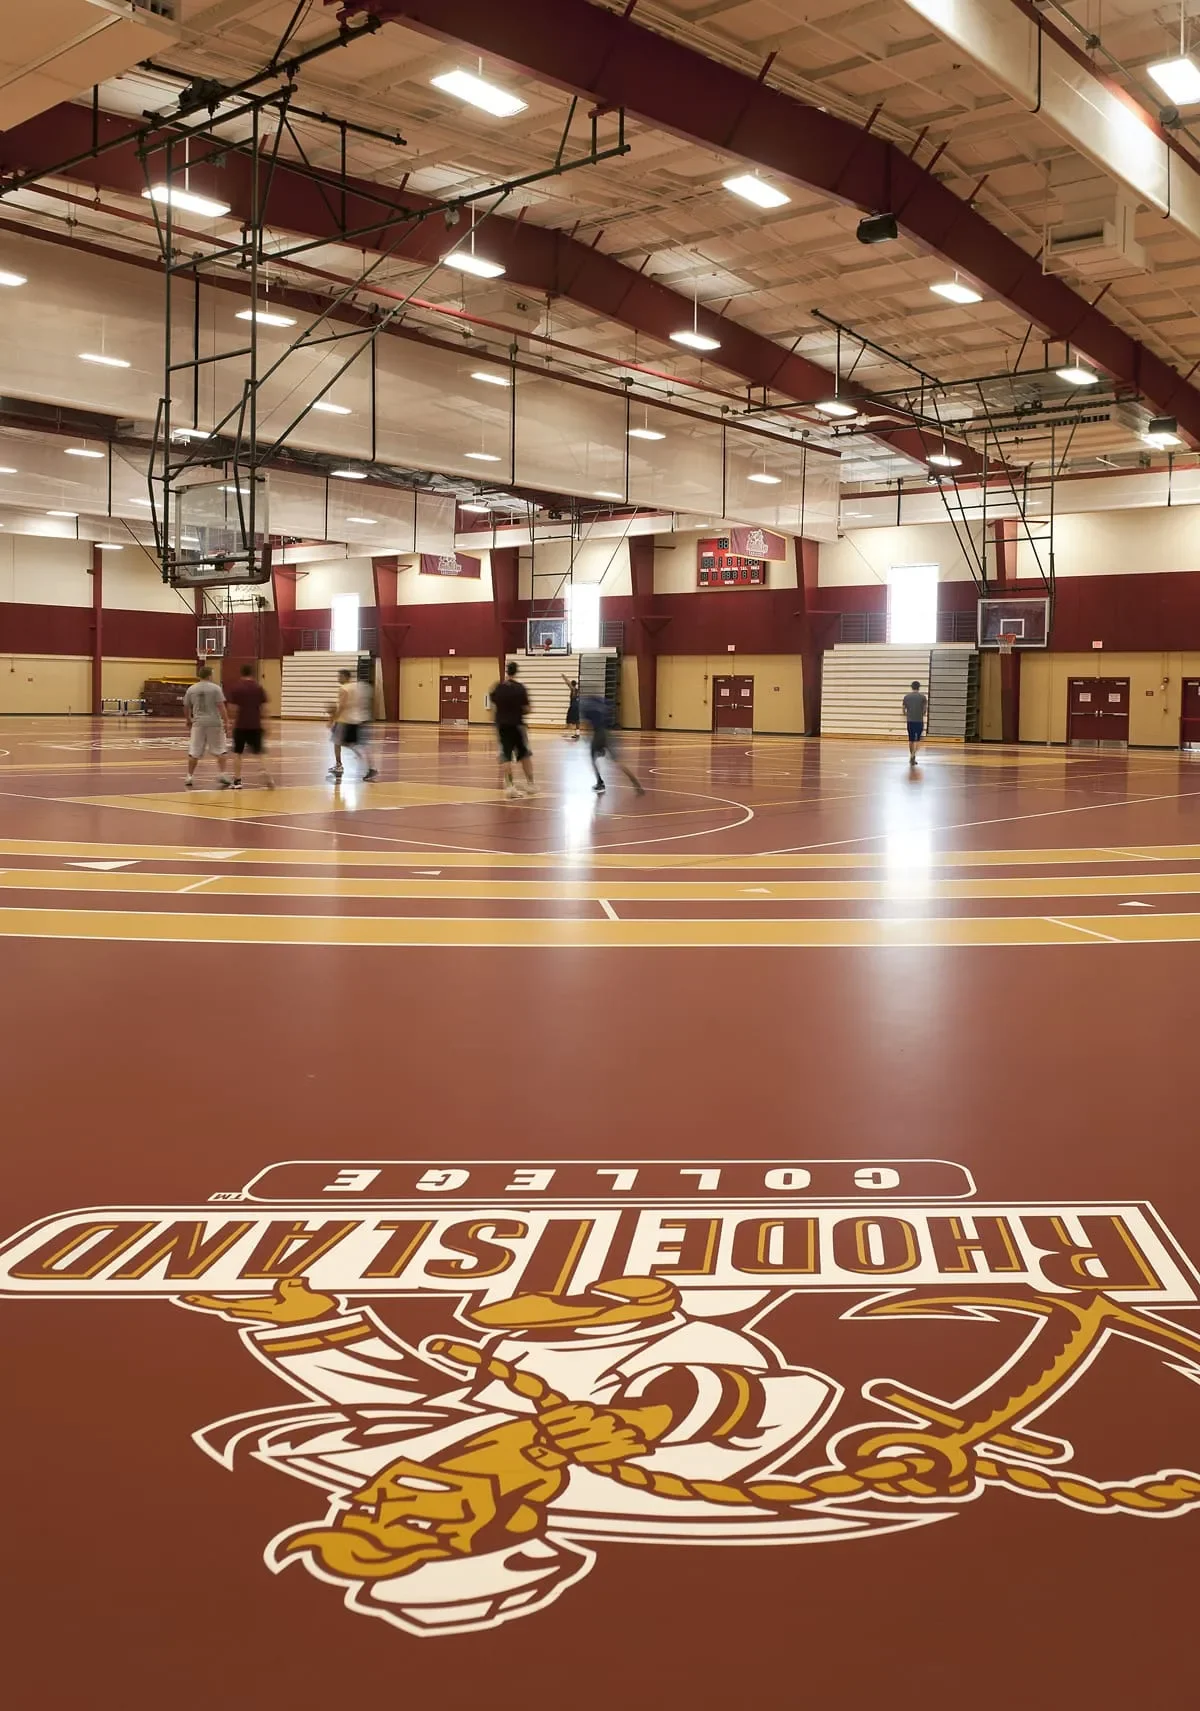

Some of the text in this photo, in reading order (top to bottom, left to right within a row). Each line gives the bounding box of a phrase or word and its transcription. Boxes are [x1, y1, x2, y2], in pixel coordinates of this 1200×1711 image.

[323, 1168, 900, 1191] COLLEGE
[7, 1215, 1168, 1297] RHODE ISLAND
